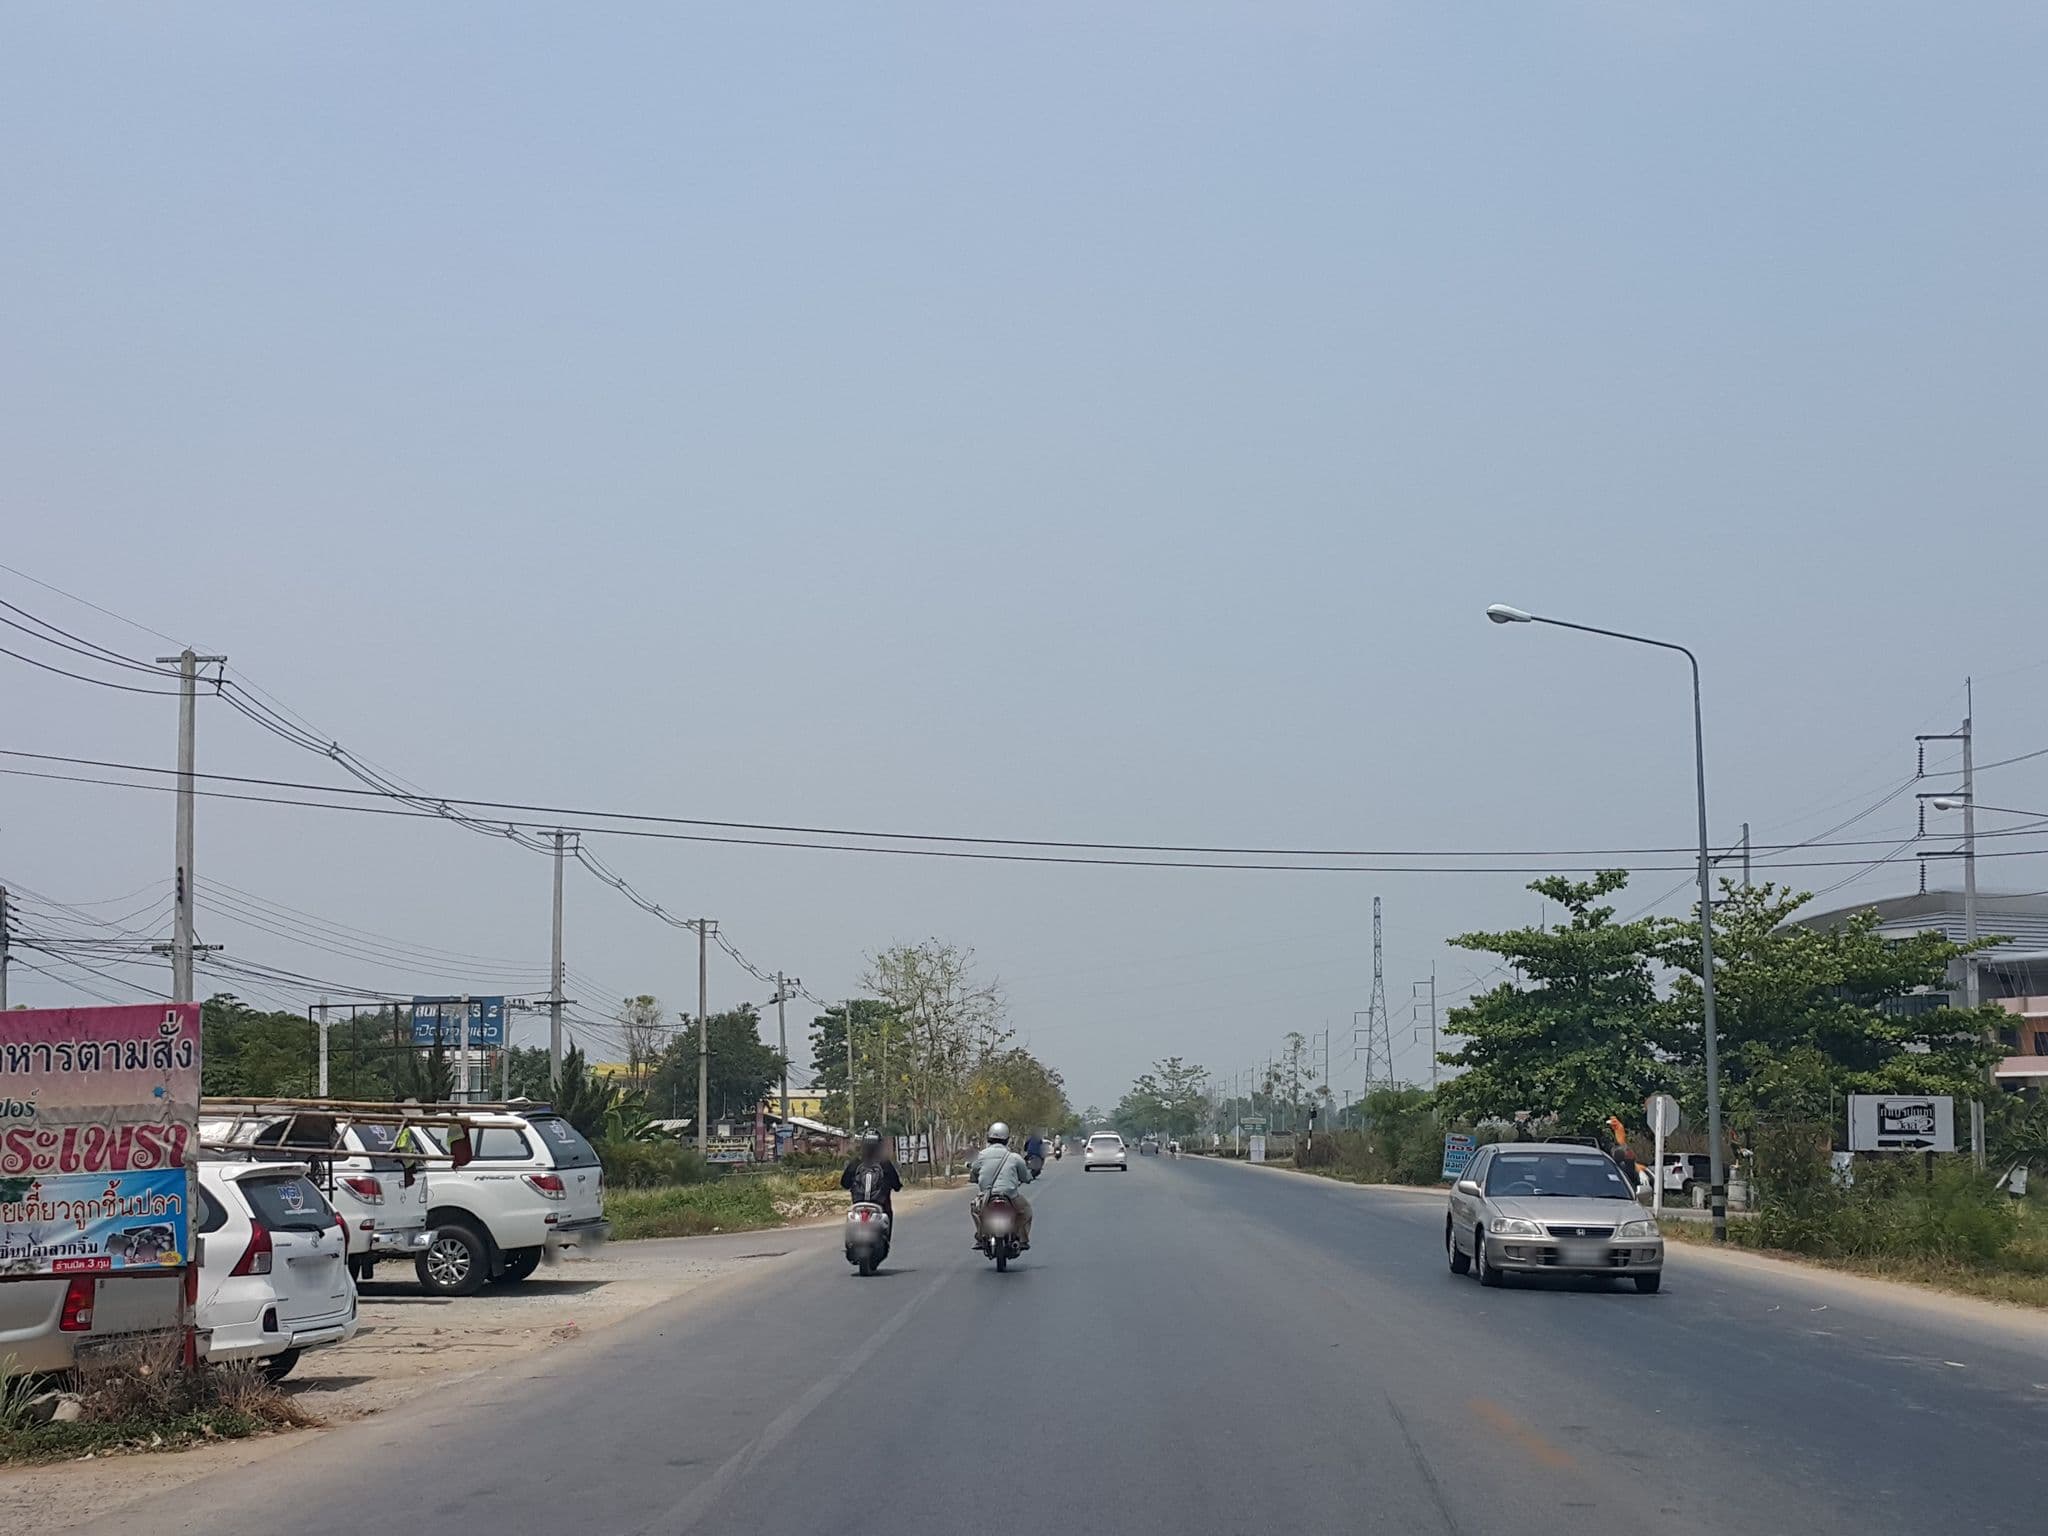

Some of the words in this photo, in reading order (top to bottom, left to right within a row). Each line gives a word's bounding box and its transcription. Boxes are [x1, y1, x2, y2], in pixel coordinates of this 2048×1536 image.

[0, 1011, 193, 1073] หารตามสั่ง
[0, 1123, 188, 1174] ระเพรา
[87, 1258, 95, 1268] 3
